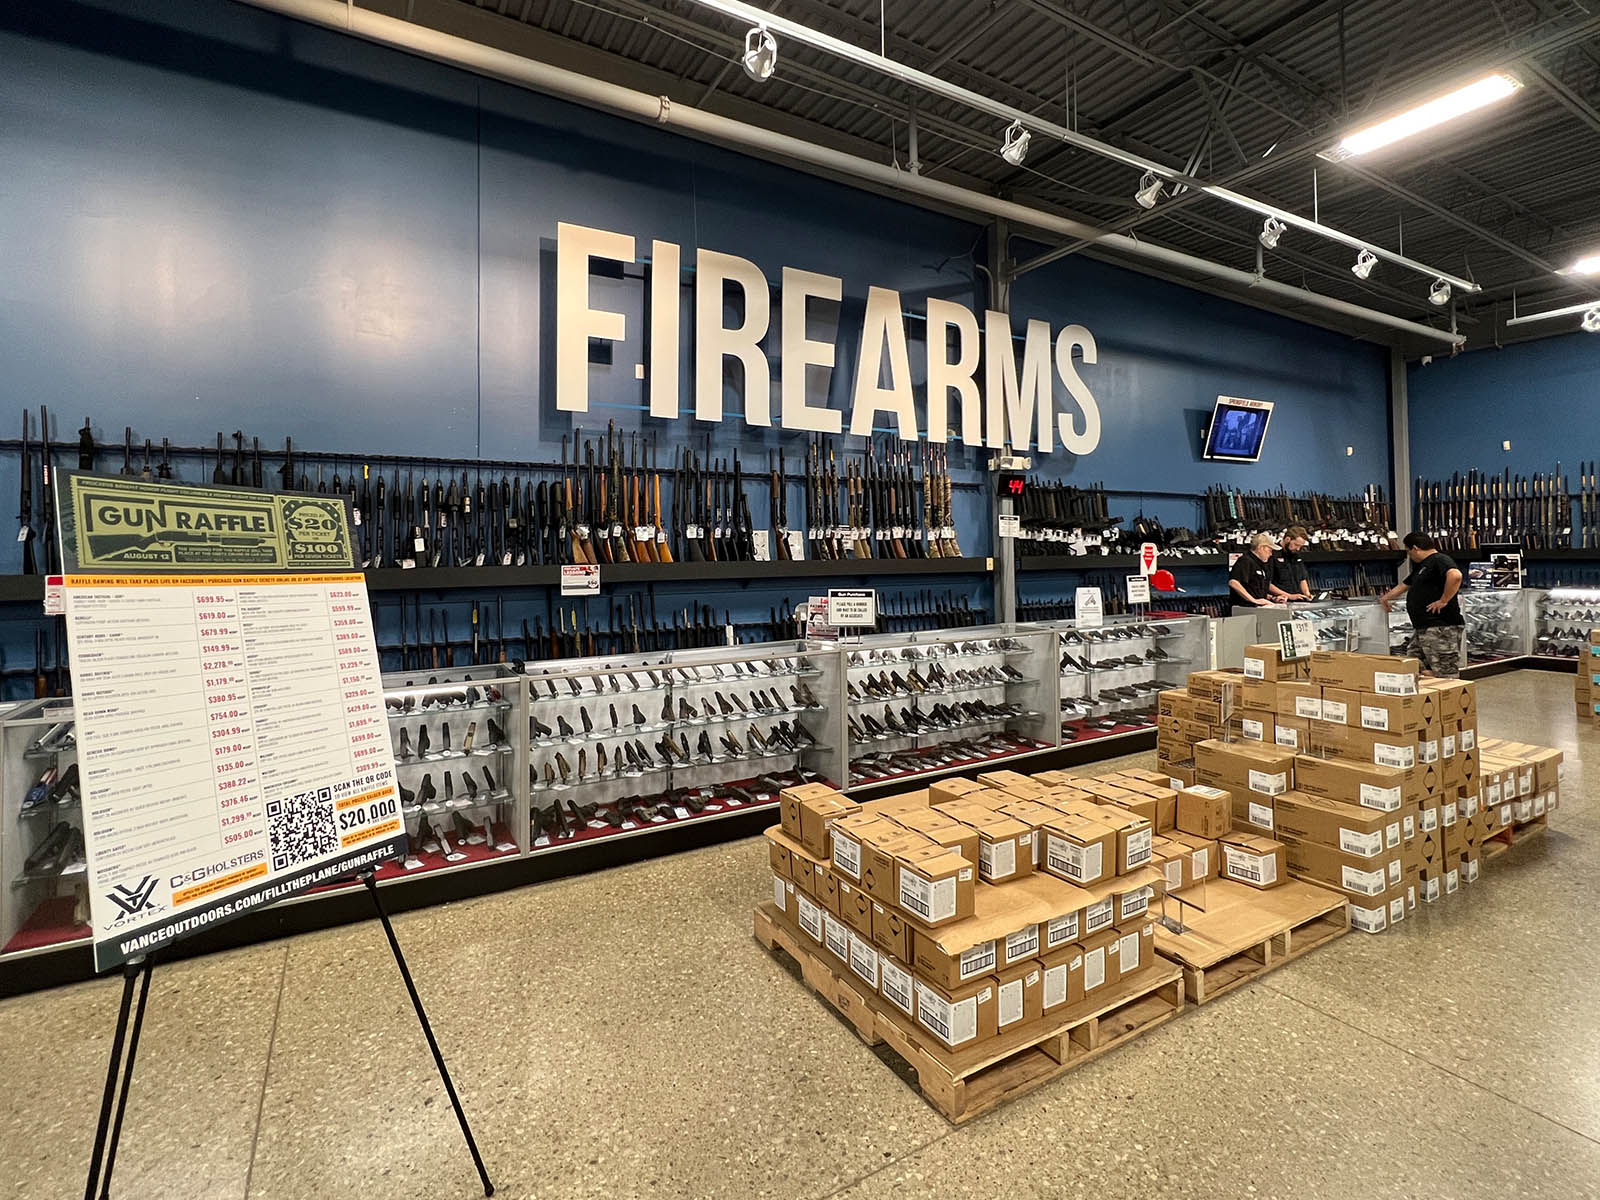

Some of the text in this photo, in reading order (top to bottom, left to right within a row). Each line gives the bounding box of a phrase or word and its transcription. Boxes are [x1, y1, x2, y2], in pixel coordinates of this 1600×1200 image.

[556, 221, 1101, 456] FIREARMS
[98, 504, 265, 533] GUN RAFFLE
[288, 516, 337, 531] $20
[294, 543, 338, 553] $100
[196, 595, 225, 604] $699.95
[199, 612, 226, 620] $619.00
[200, 628, 228, 636] $679.99
[202, 644, 230, 653] $149.99
[210, 710, 238, 721] $754.00
[212, 727, 240, 738] $304.99
[215, 743, 242, 756] $179.00
[217, 760, 244, 773] $135.00
[218, 777, 247, 790] $388.22
[333, 771, 392, 793] SCAN THE QR CODE
[221, 795, 248, 808] $376.46
[339, 799, 396, 831] $20,000
[224, 829, 253, 845] $505.00
[170, 867, 205, 888] C&G
[206, 849, 264, 875] HOLSTERS
[120, 844, 395, 955] VANCEOUTDOORS.COM/FILLTHEPLANE/GUNRAFFLE
[103, 904, 167, 931] VORTEX
